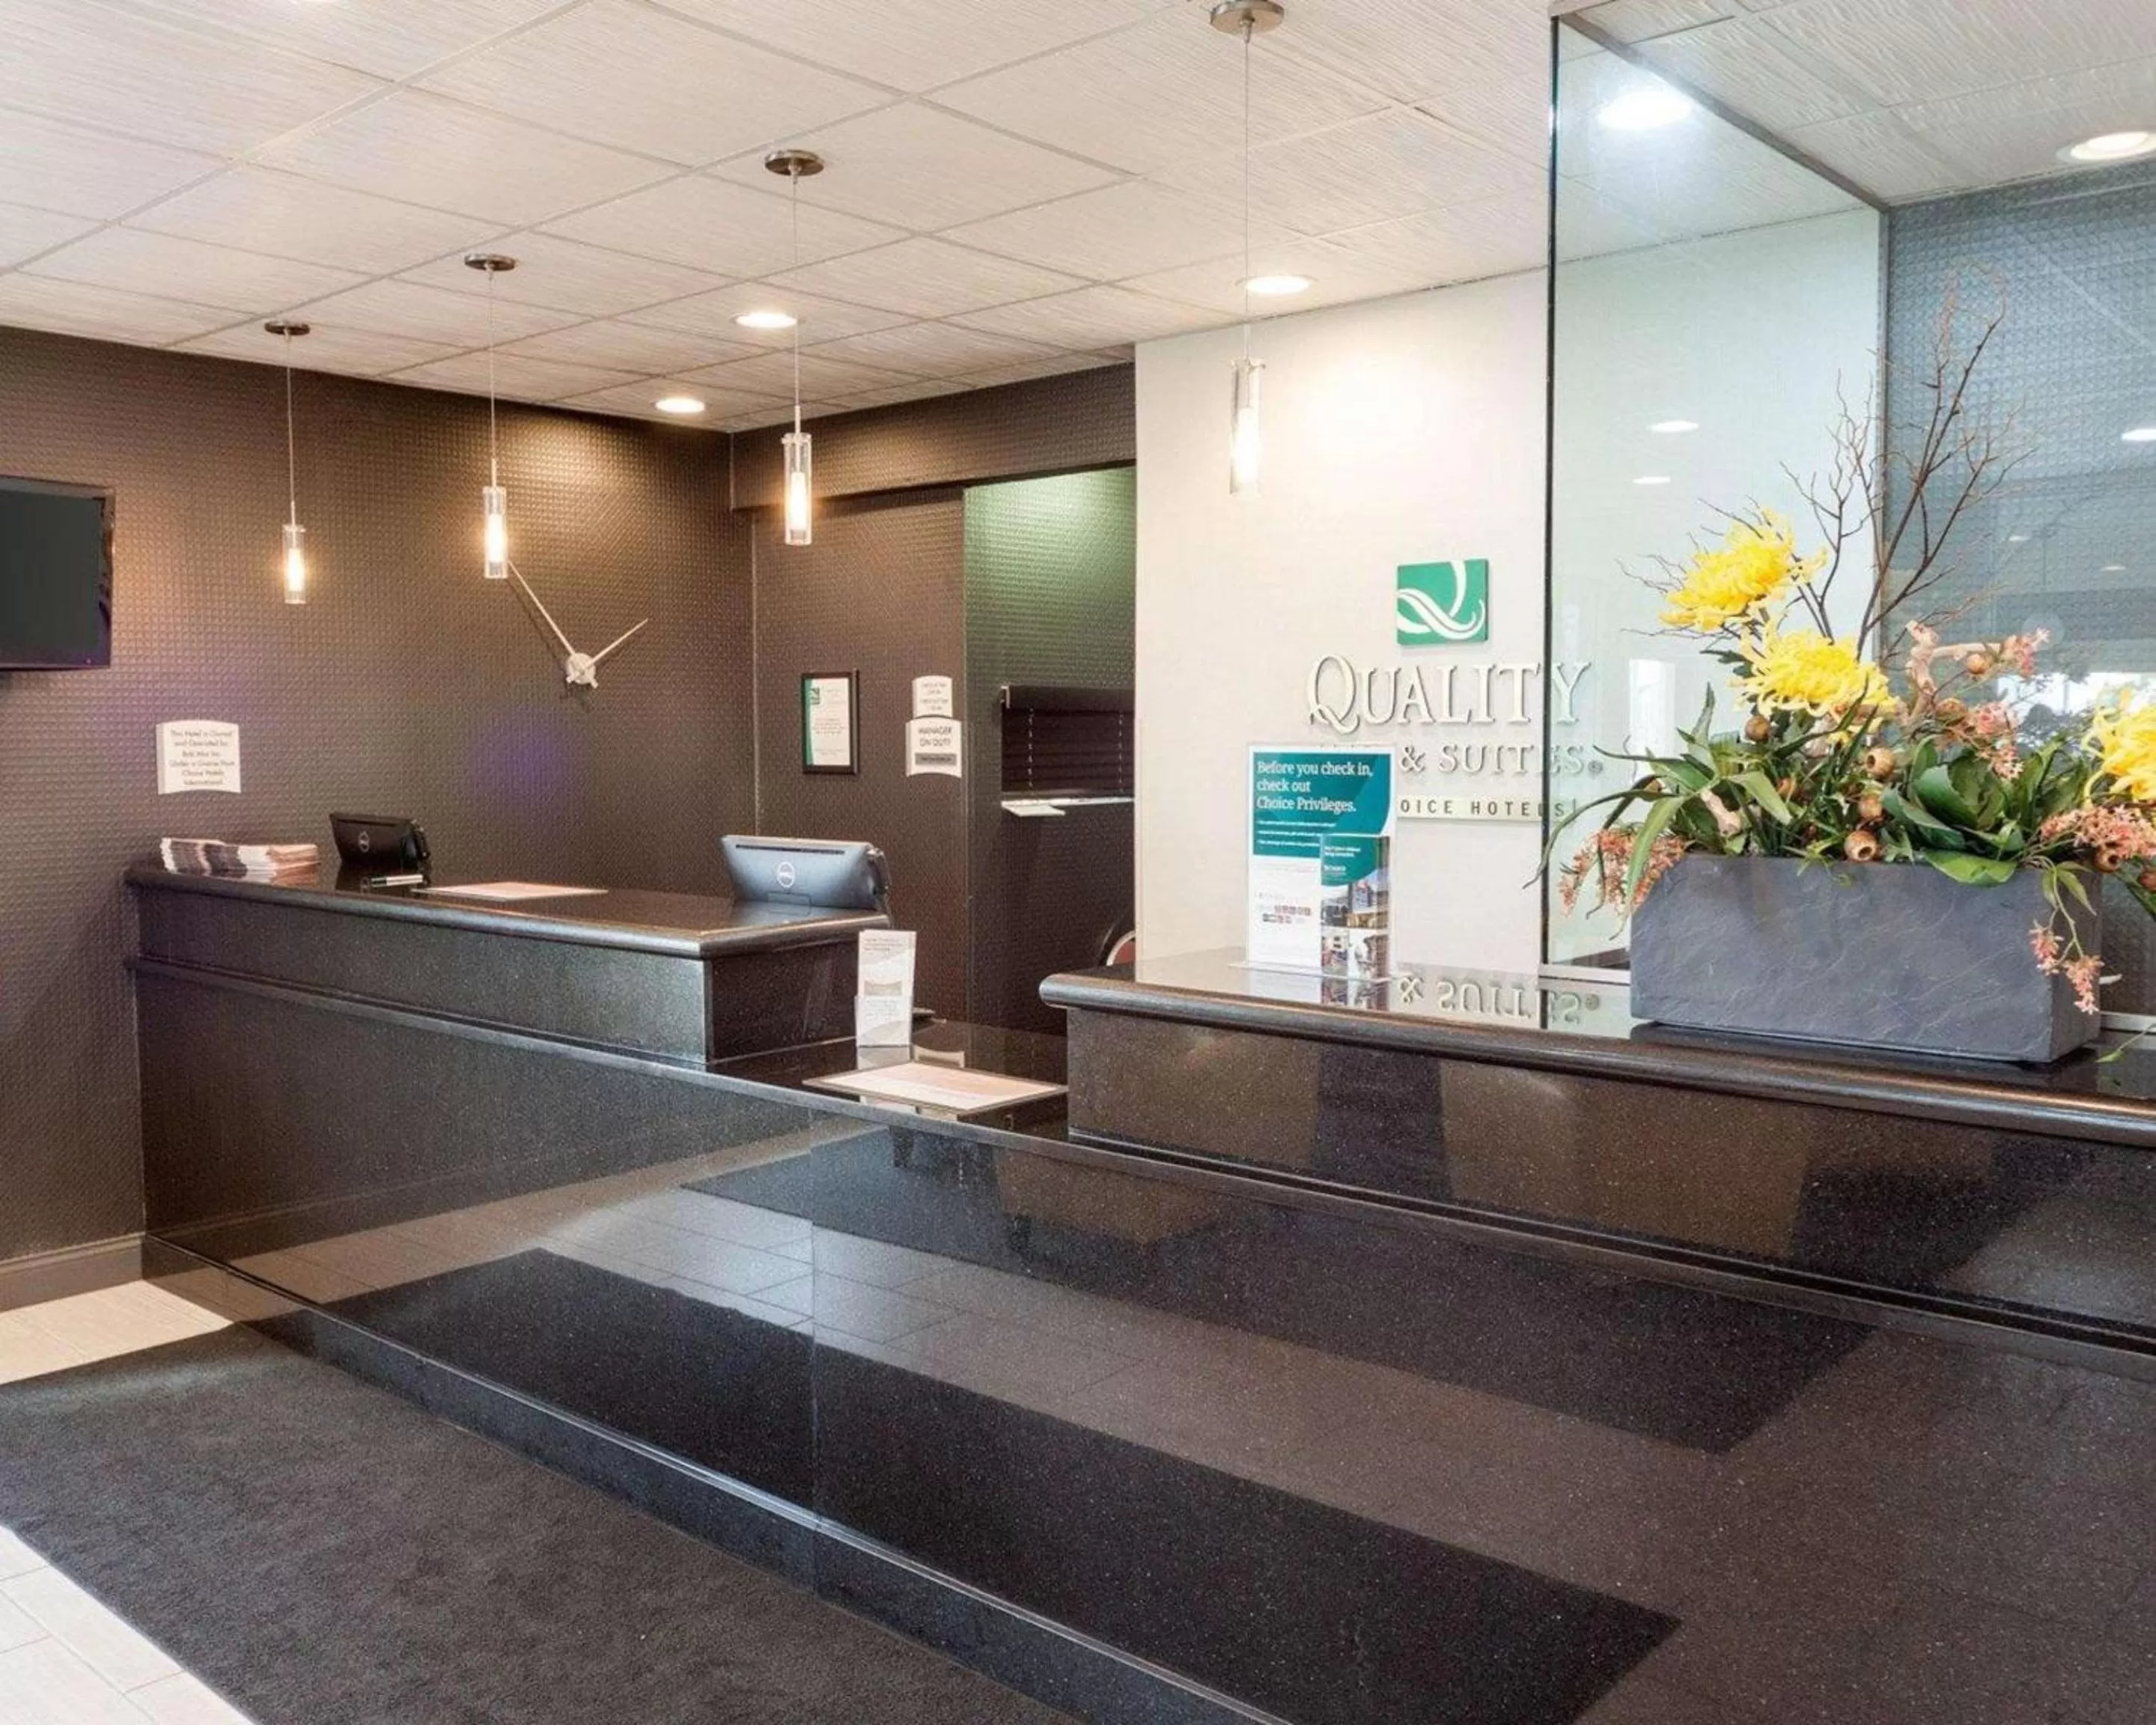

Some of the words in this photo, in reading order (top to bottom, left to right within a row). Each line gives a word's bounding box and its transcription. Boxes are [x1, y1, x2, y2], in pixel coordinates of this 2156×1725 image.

[1306, 654, 1592, 734] QUALITY
[1399, 746, 1426, 773] &
[1256, 761, 1294, 774] Before
[1297, 764, 1319, 778] you
[1321, 761, 1356, 776] check
[1357, 762, 1374, 777] in,
[1256, 779, 1290, 792] check
[1291, 780, 1311, 793] out
[1256, 796, 1294, 809] Choice
[1297, 797, 1357, 815] Privileges.
[1401, 800, 1453, 815] OICE
